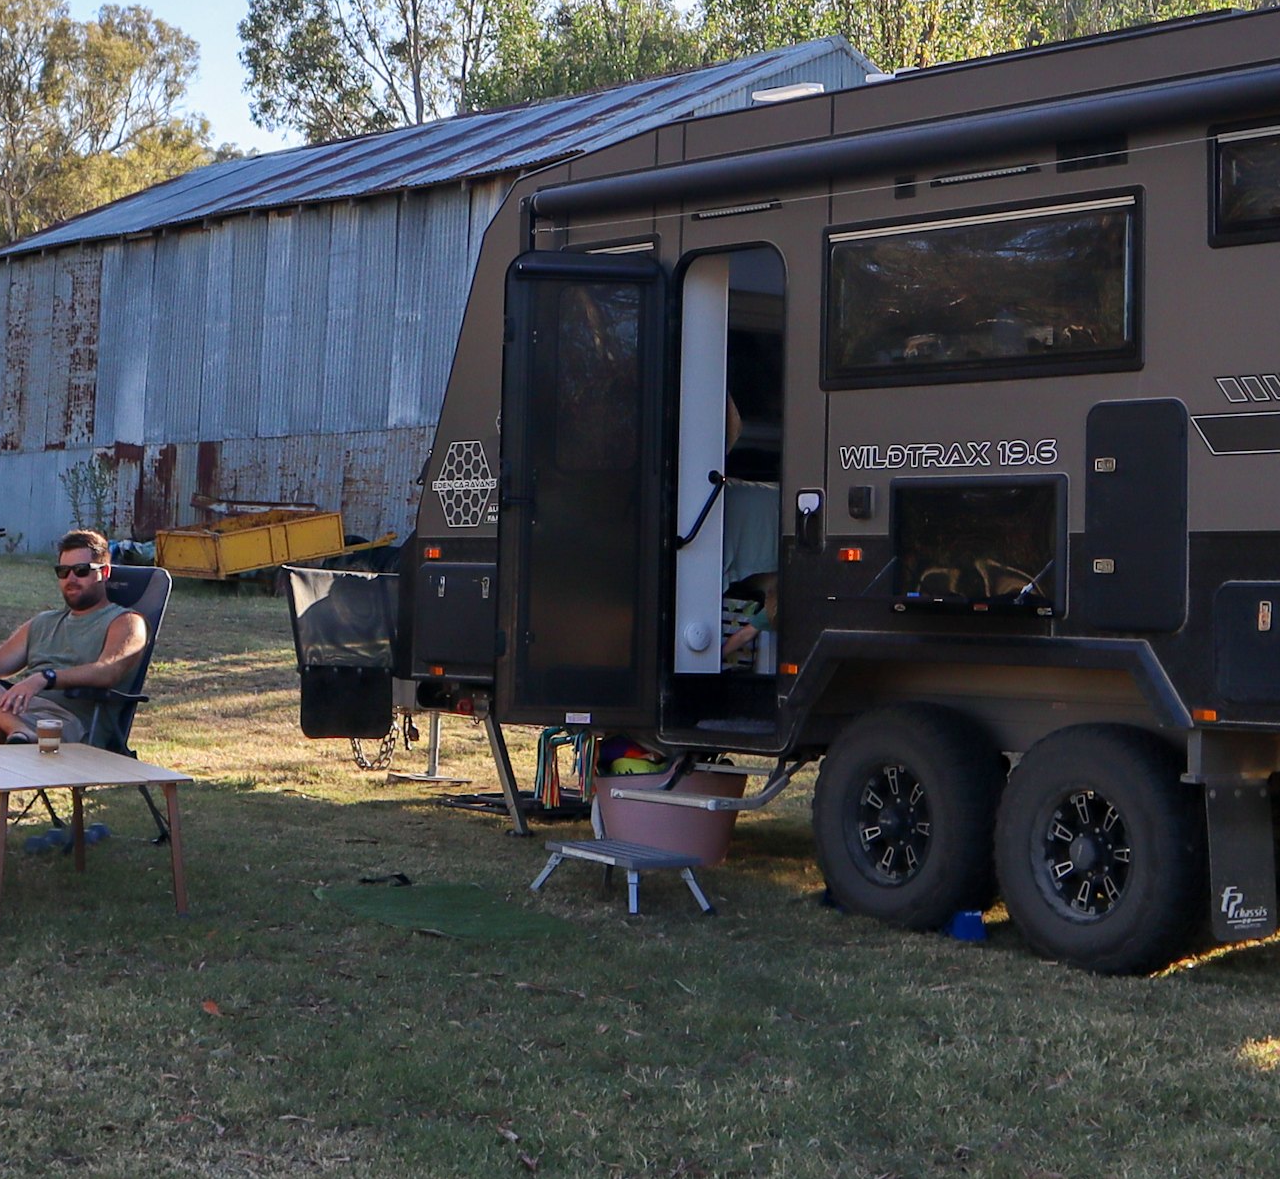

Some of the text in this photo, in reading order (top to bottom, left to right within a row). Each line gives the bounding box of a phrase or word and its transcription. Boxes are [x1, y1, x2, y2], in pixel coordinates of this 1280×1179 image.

[840, 439, 1058, 470] WILDTRAX 19.6
[432, 479, 497, 491] EDEN CARAVANS
[1234, 906, 1268, 918] chassis
